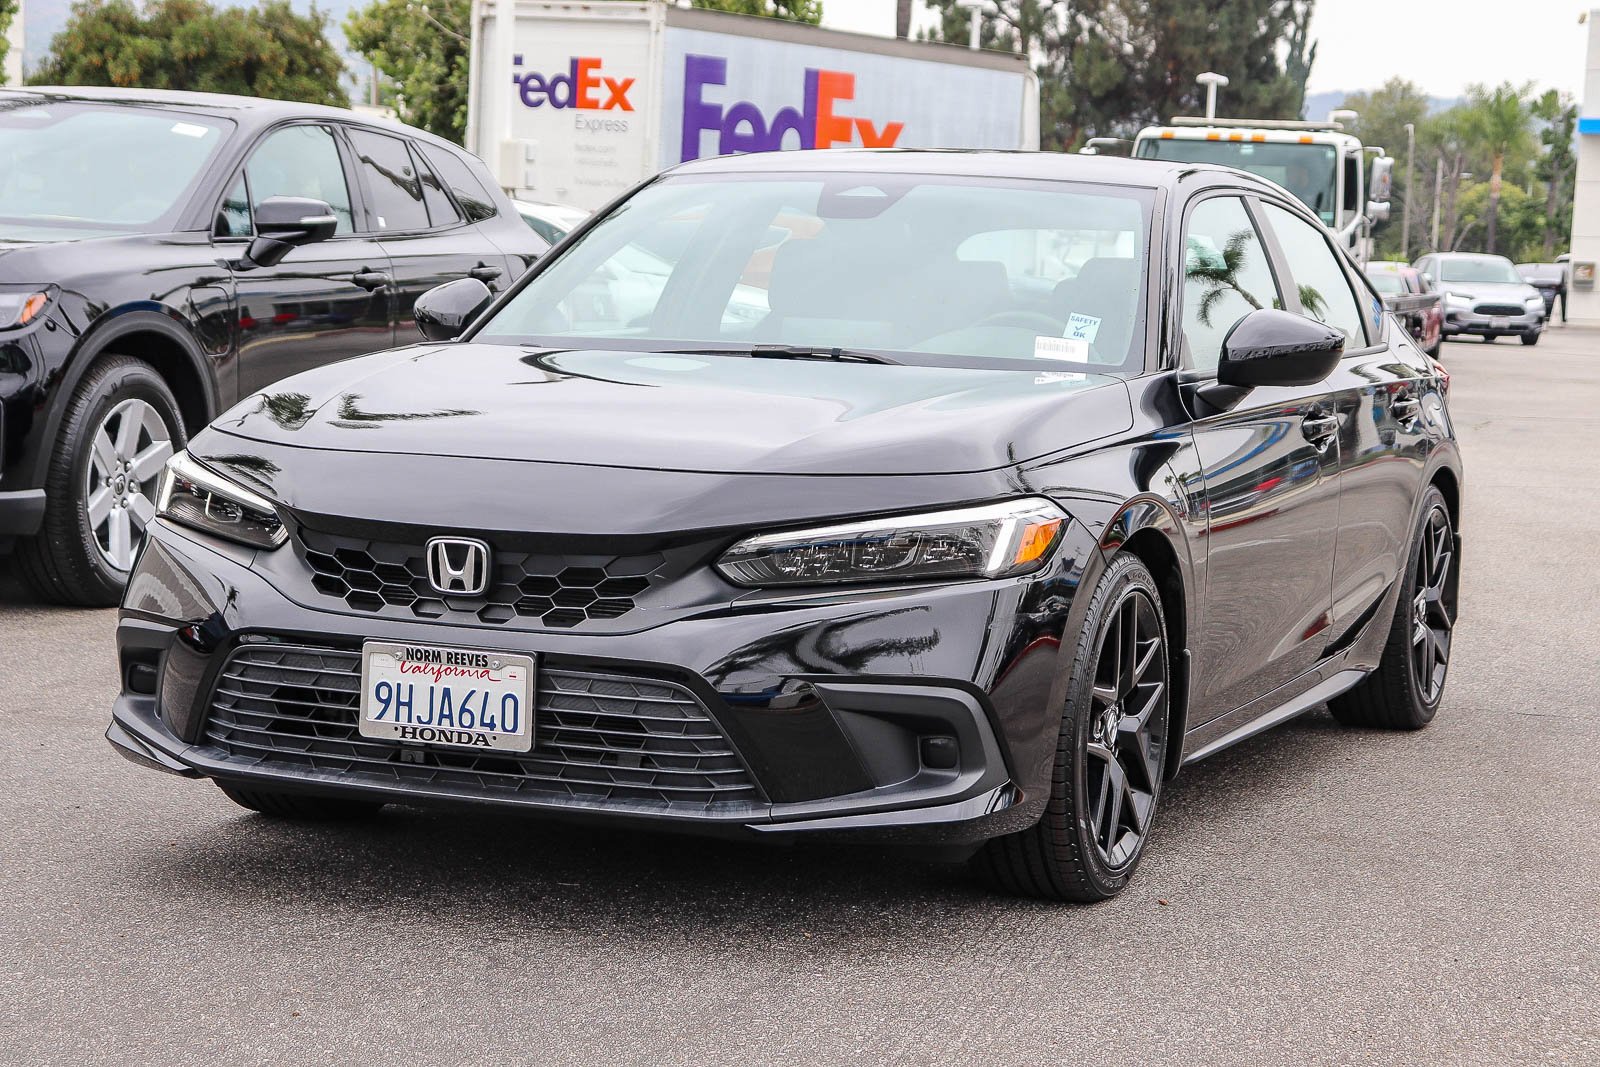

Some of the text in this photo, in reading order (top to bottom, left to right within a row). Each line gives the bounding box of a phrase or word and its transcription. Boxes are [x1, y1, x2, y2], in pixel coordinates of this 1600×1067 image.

[575, 114, 628, 132] Express
[1070, 315, 1098, 326] SAFETY
[405, 647, 489, 667] NORM REEVES
[400, 660, 502, 683] California
[374, 681, 519, 733] 9HJA640
[399, 725, 492, 747] HONDA
